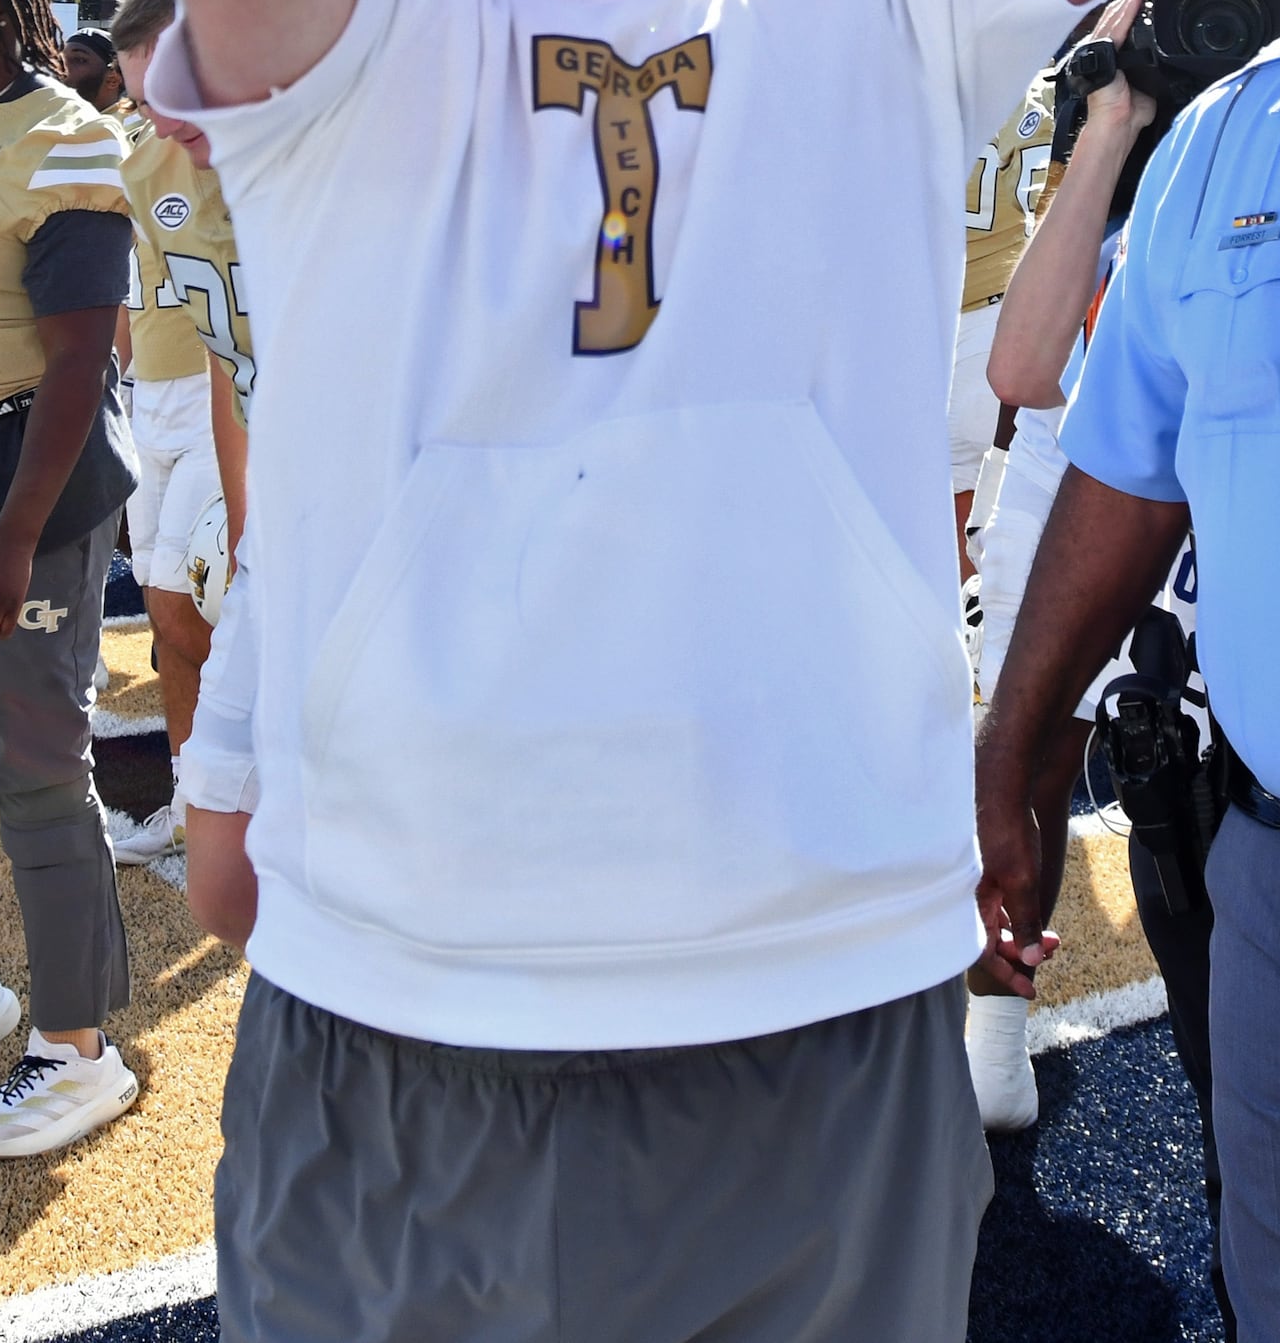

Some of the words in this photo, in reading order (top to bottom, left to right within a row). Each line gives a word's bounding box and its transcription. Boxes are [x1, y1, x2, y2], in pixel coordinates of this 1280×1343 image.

[160, 204, 184, 216] ACC
[1231, 231, 1266, 244] FORREST
[17, 600, 68, 633] GT
